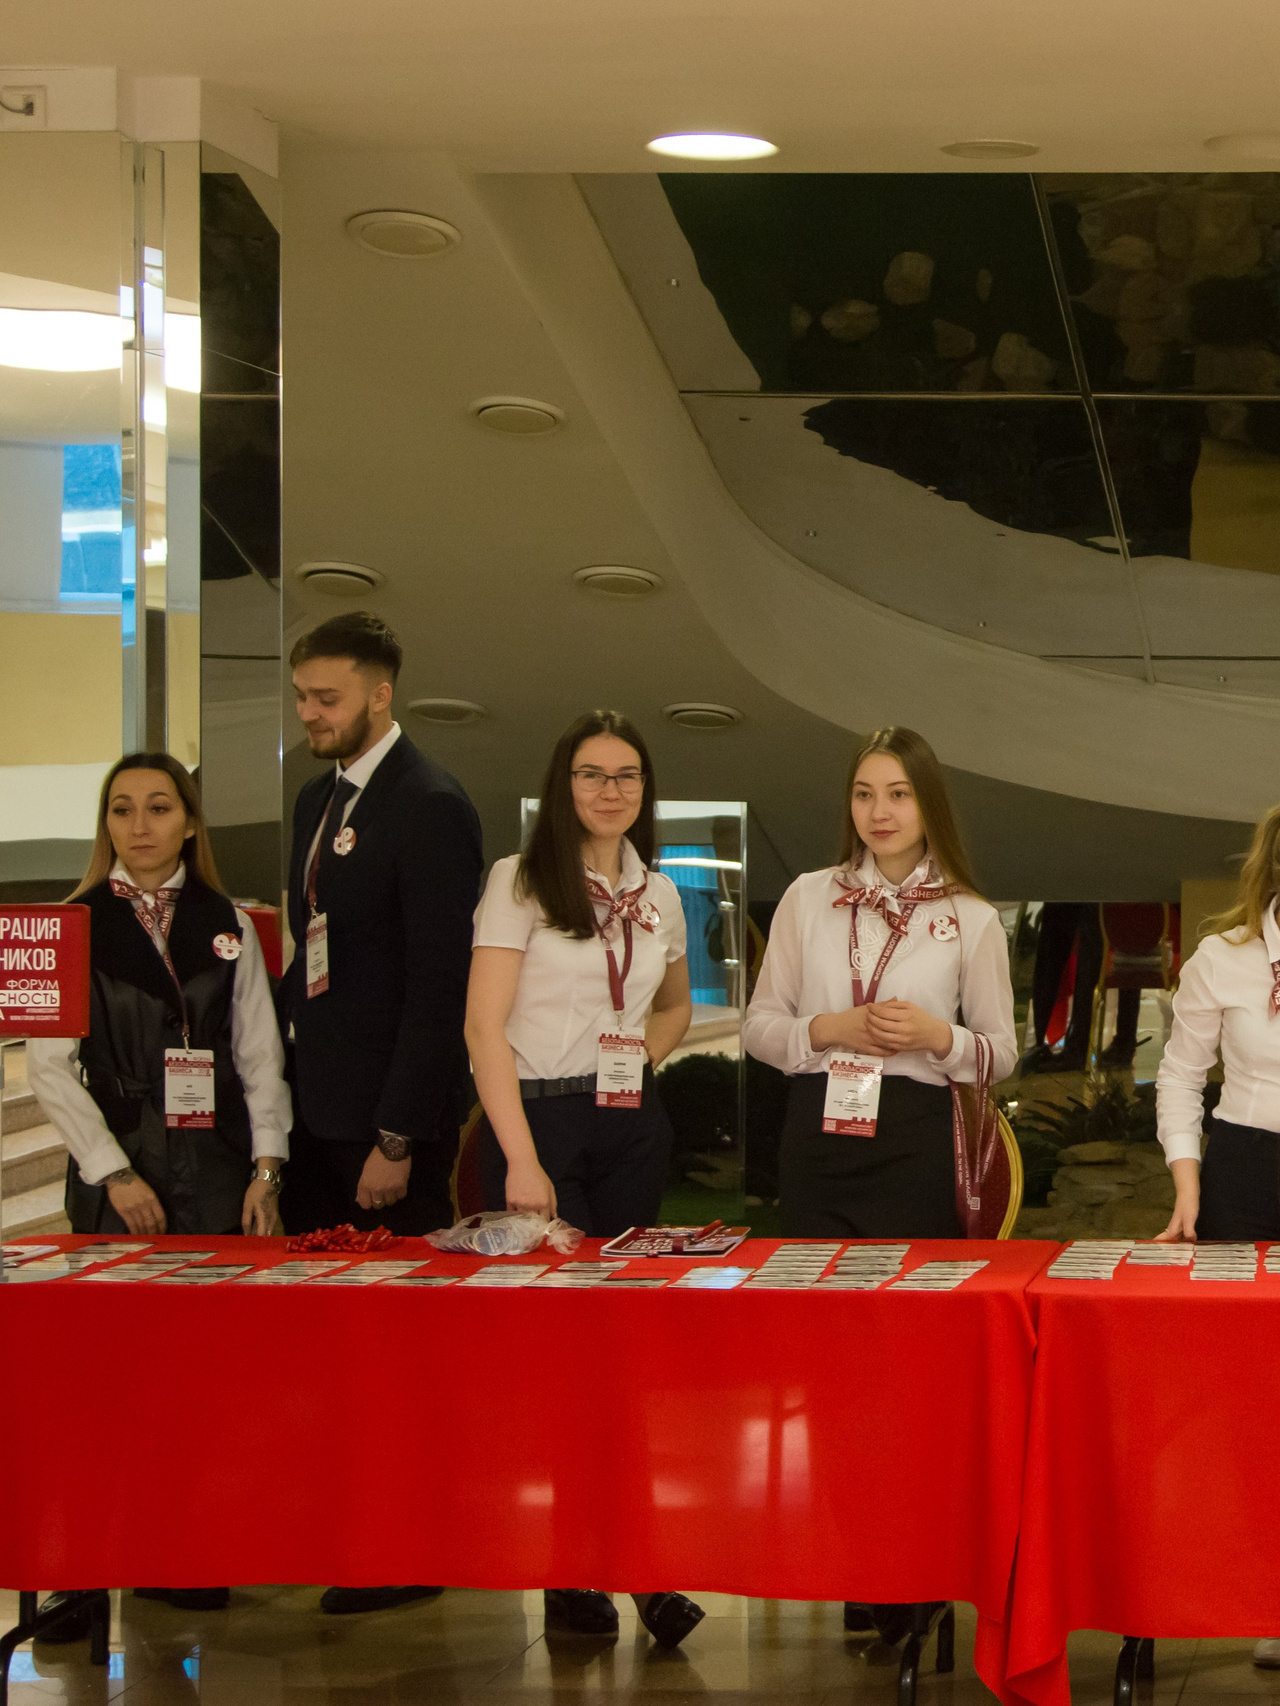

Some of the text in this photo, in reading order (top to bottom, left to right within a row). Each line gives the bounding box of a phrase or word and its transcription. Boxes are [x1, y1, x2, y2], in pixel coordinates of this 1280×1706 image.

[0, 917, 61, 943] РАЦИЯ
[0, 948, 57, 971] НИКОВ
[6, 979, 59, 990] ФОРУМ
[0, 993, 58, 1005] СНОСТЬ
